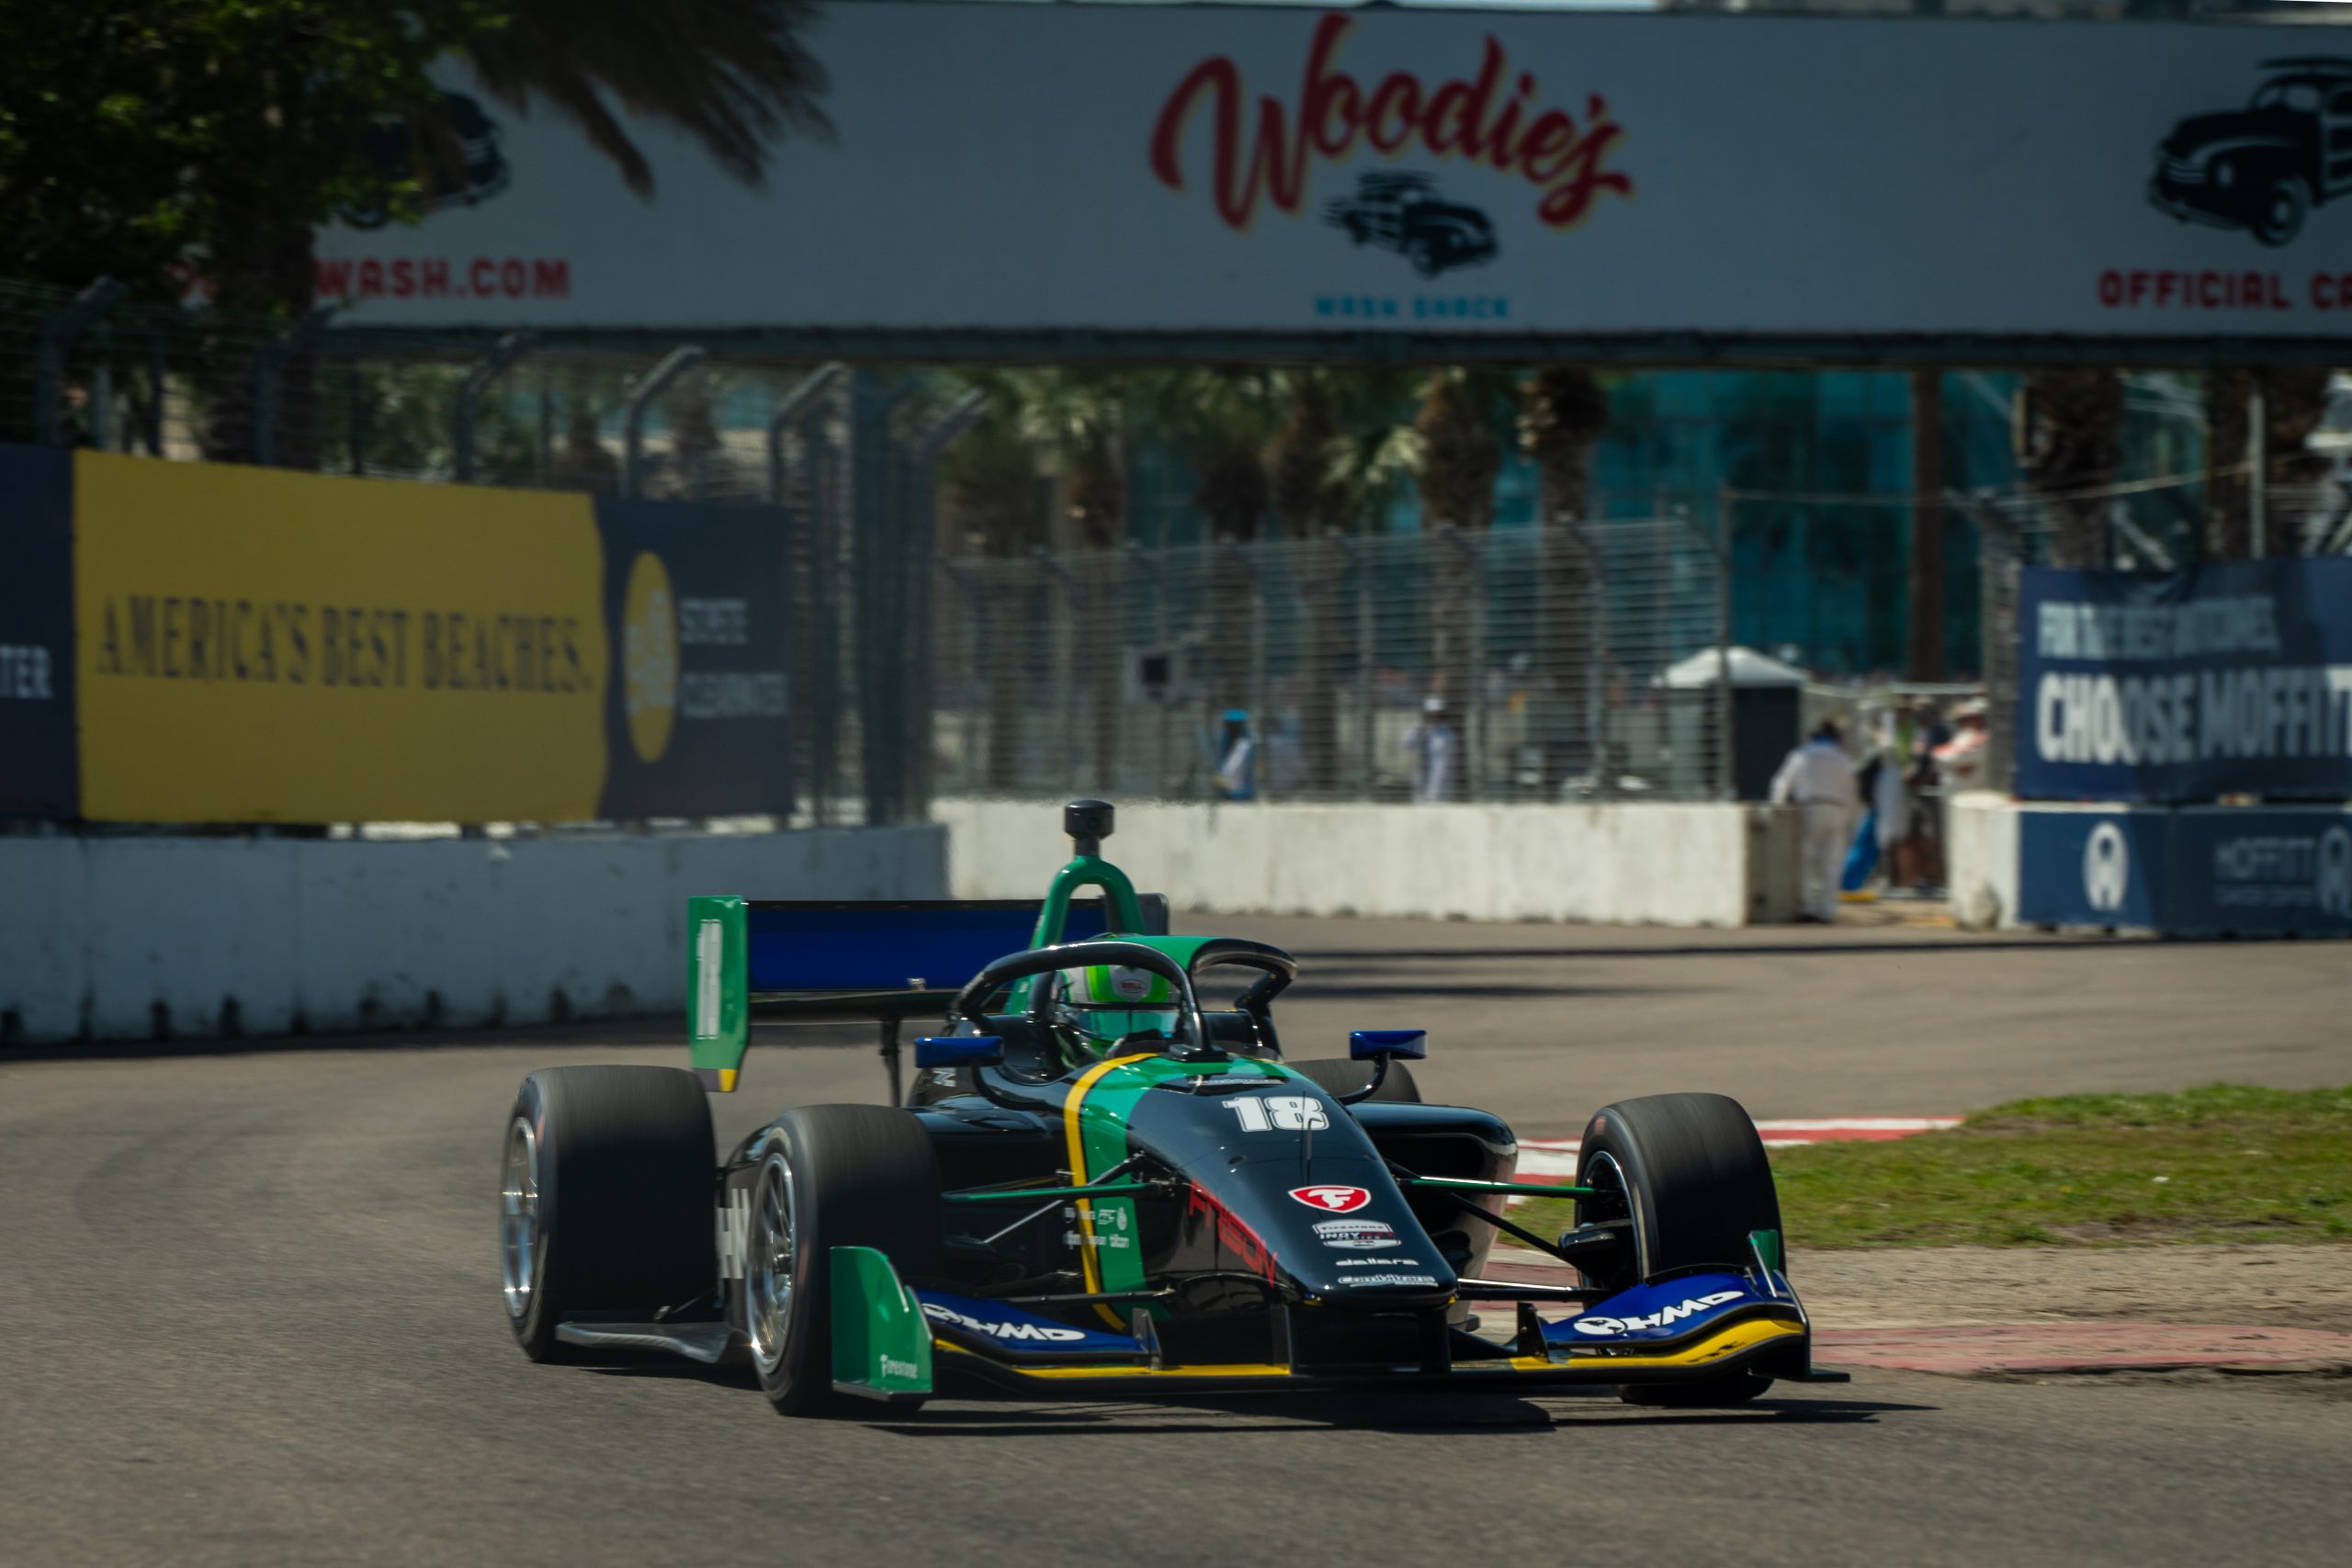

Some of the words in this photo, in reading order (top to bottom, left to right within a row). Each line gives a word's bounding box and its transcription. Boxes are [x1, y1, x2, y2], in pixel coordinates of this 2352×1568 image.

[1151, 10, 1635, 230] Woodie's
[2098, 269, 2291, 310] OFFICIAL
[96, 594, 309, 685] AMERICA'S
[322, 605, 407, 688] BEST
[2036, 670, 2194, 765] CHOOSE
[1221, 1096, 1329, 1132] 18
[961, 1314, 1086, 1342] HMD
[1619, 1290, 1745, 1331] HMD
